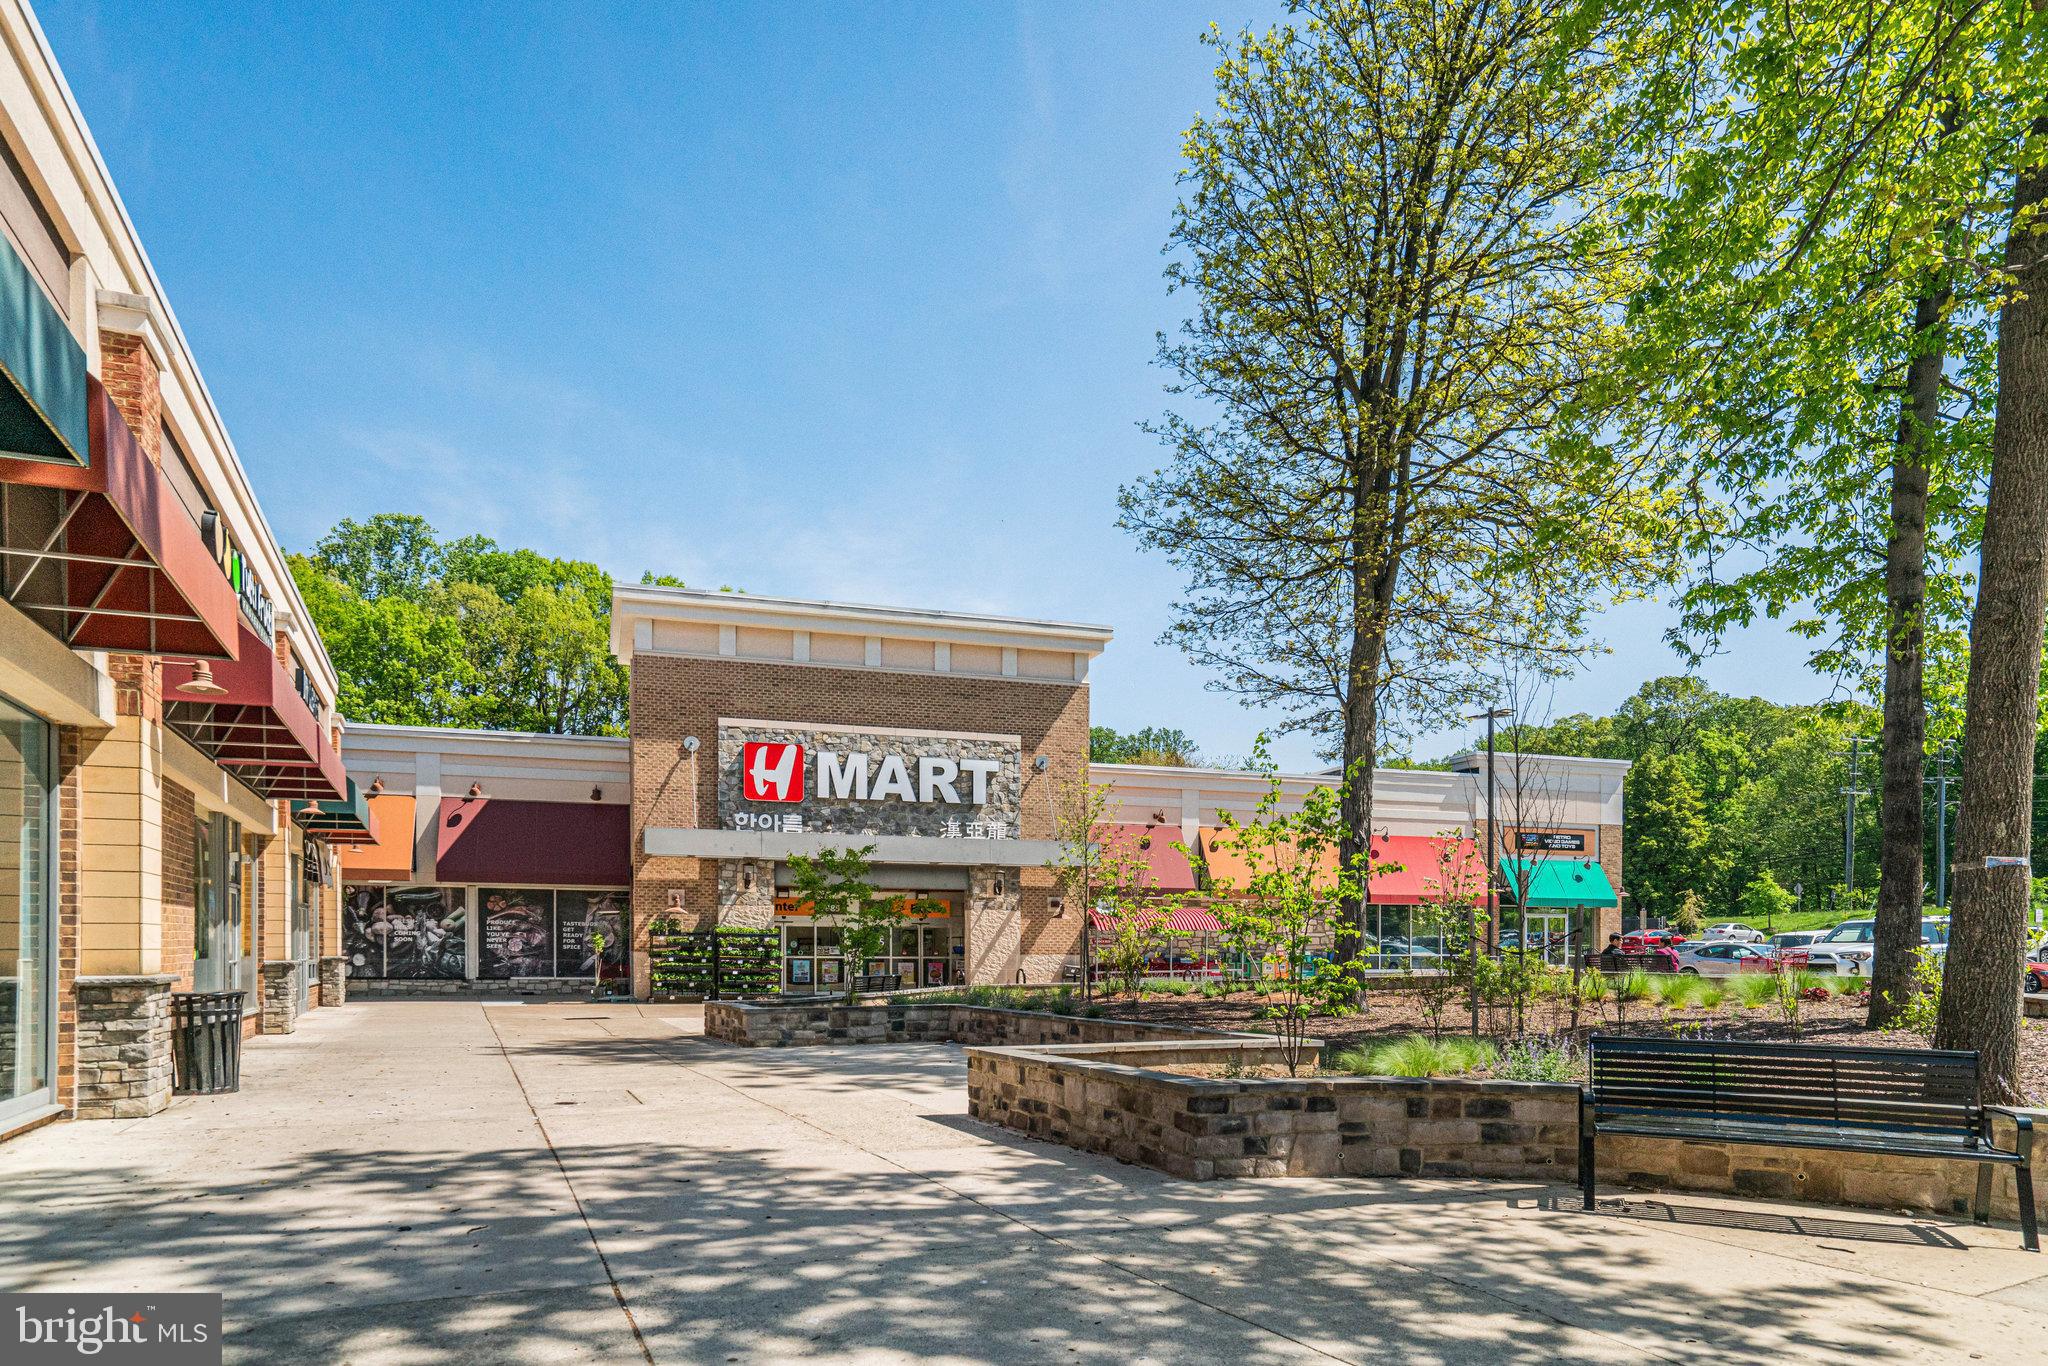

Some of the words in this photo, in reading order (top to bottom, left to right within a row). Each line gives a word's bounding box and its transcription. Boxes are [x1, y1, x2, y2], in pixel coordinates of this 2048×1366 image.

[749, 744, 798, 801] H
[817, 751, 1000, 805] MART
[734, 812, 803, 833] 한아름
[939, 818, 1009, 840] 漢亞龍
